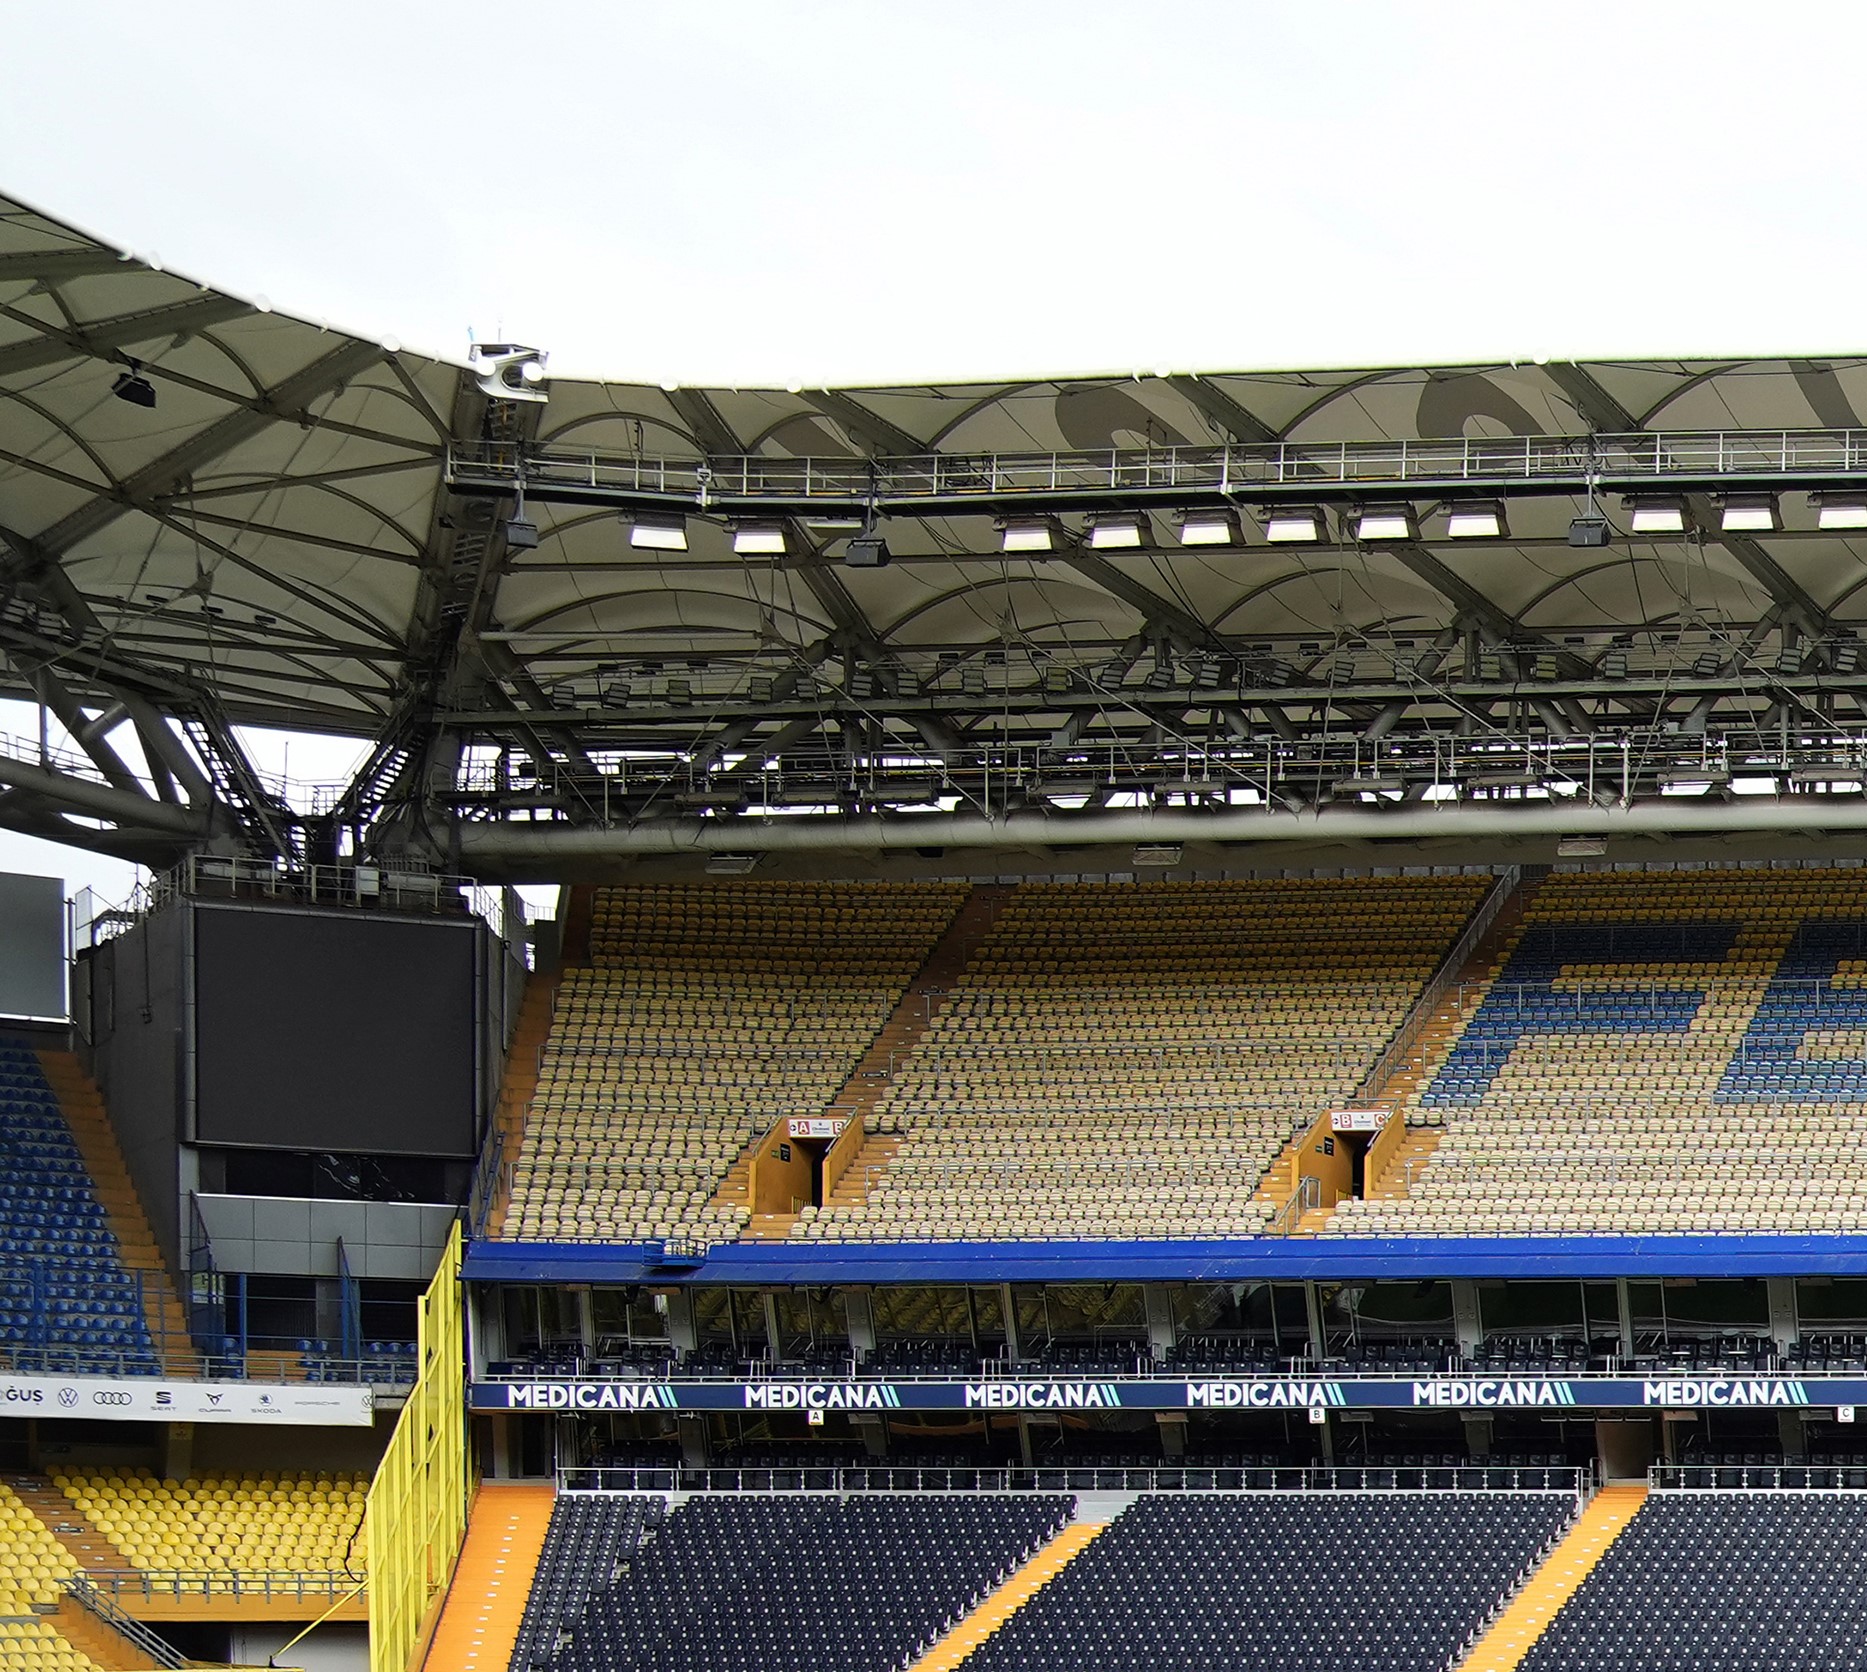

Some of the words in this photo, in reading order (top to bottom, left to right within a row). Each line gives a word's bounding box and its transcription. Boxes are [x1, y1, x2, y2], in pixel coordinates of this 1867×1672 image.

[0, 1386, 44, 1405] ĞUŞ
[507, 1385, 659, 1408] MEDICANA
[744, 1386, 884, 1408] MEDICANA
[964, 1385, 1102, 1407] MEDICANA
[1187, 1383, 1327, 1406] MEDICANA
[1412, 1382, 1556, 1405] MEDICANA
[1643, 1381, 1788, 1404] MEDICANA
